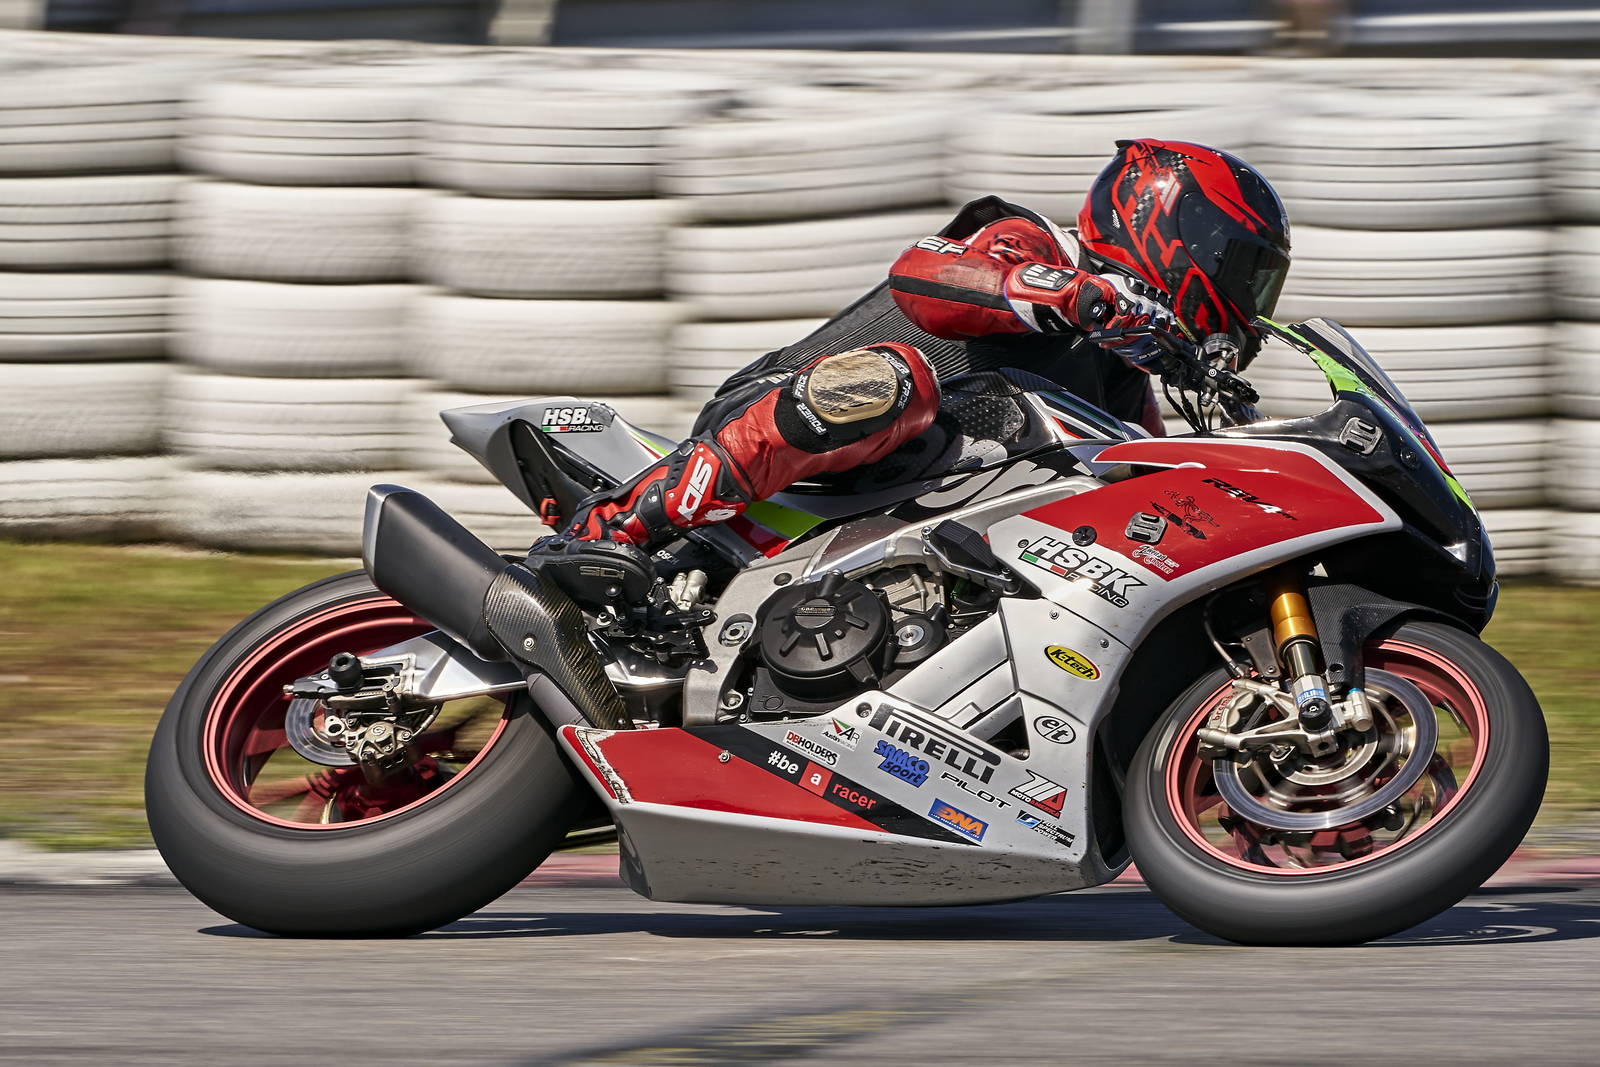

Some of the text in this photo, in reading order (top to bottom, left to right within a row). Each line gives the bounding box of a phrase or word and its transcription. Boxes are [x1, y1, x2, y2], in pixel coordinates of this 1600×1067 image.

[794, 374, 827, 435] POWER FACE
[568, 424, 604, 432] RACING
[1025, 535, 1148, 598] HSBK
[786, 731, 838, 766] DBHOLDERS
[868, 702, 1002, 785] PIRELLI
[873, 740, 930, 775] SAMCO
[767, 750, 799, 774] #be
[810, 773, 822, 786] a
[832, 783, 877, 809] racer
[940, 771, 1012, 808] PILOT
[937, 806, 984, 836] DNA
